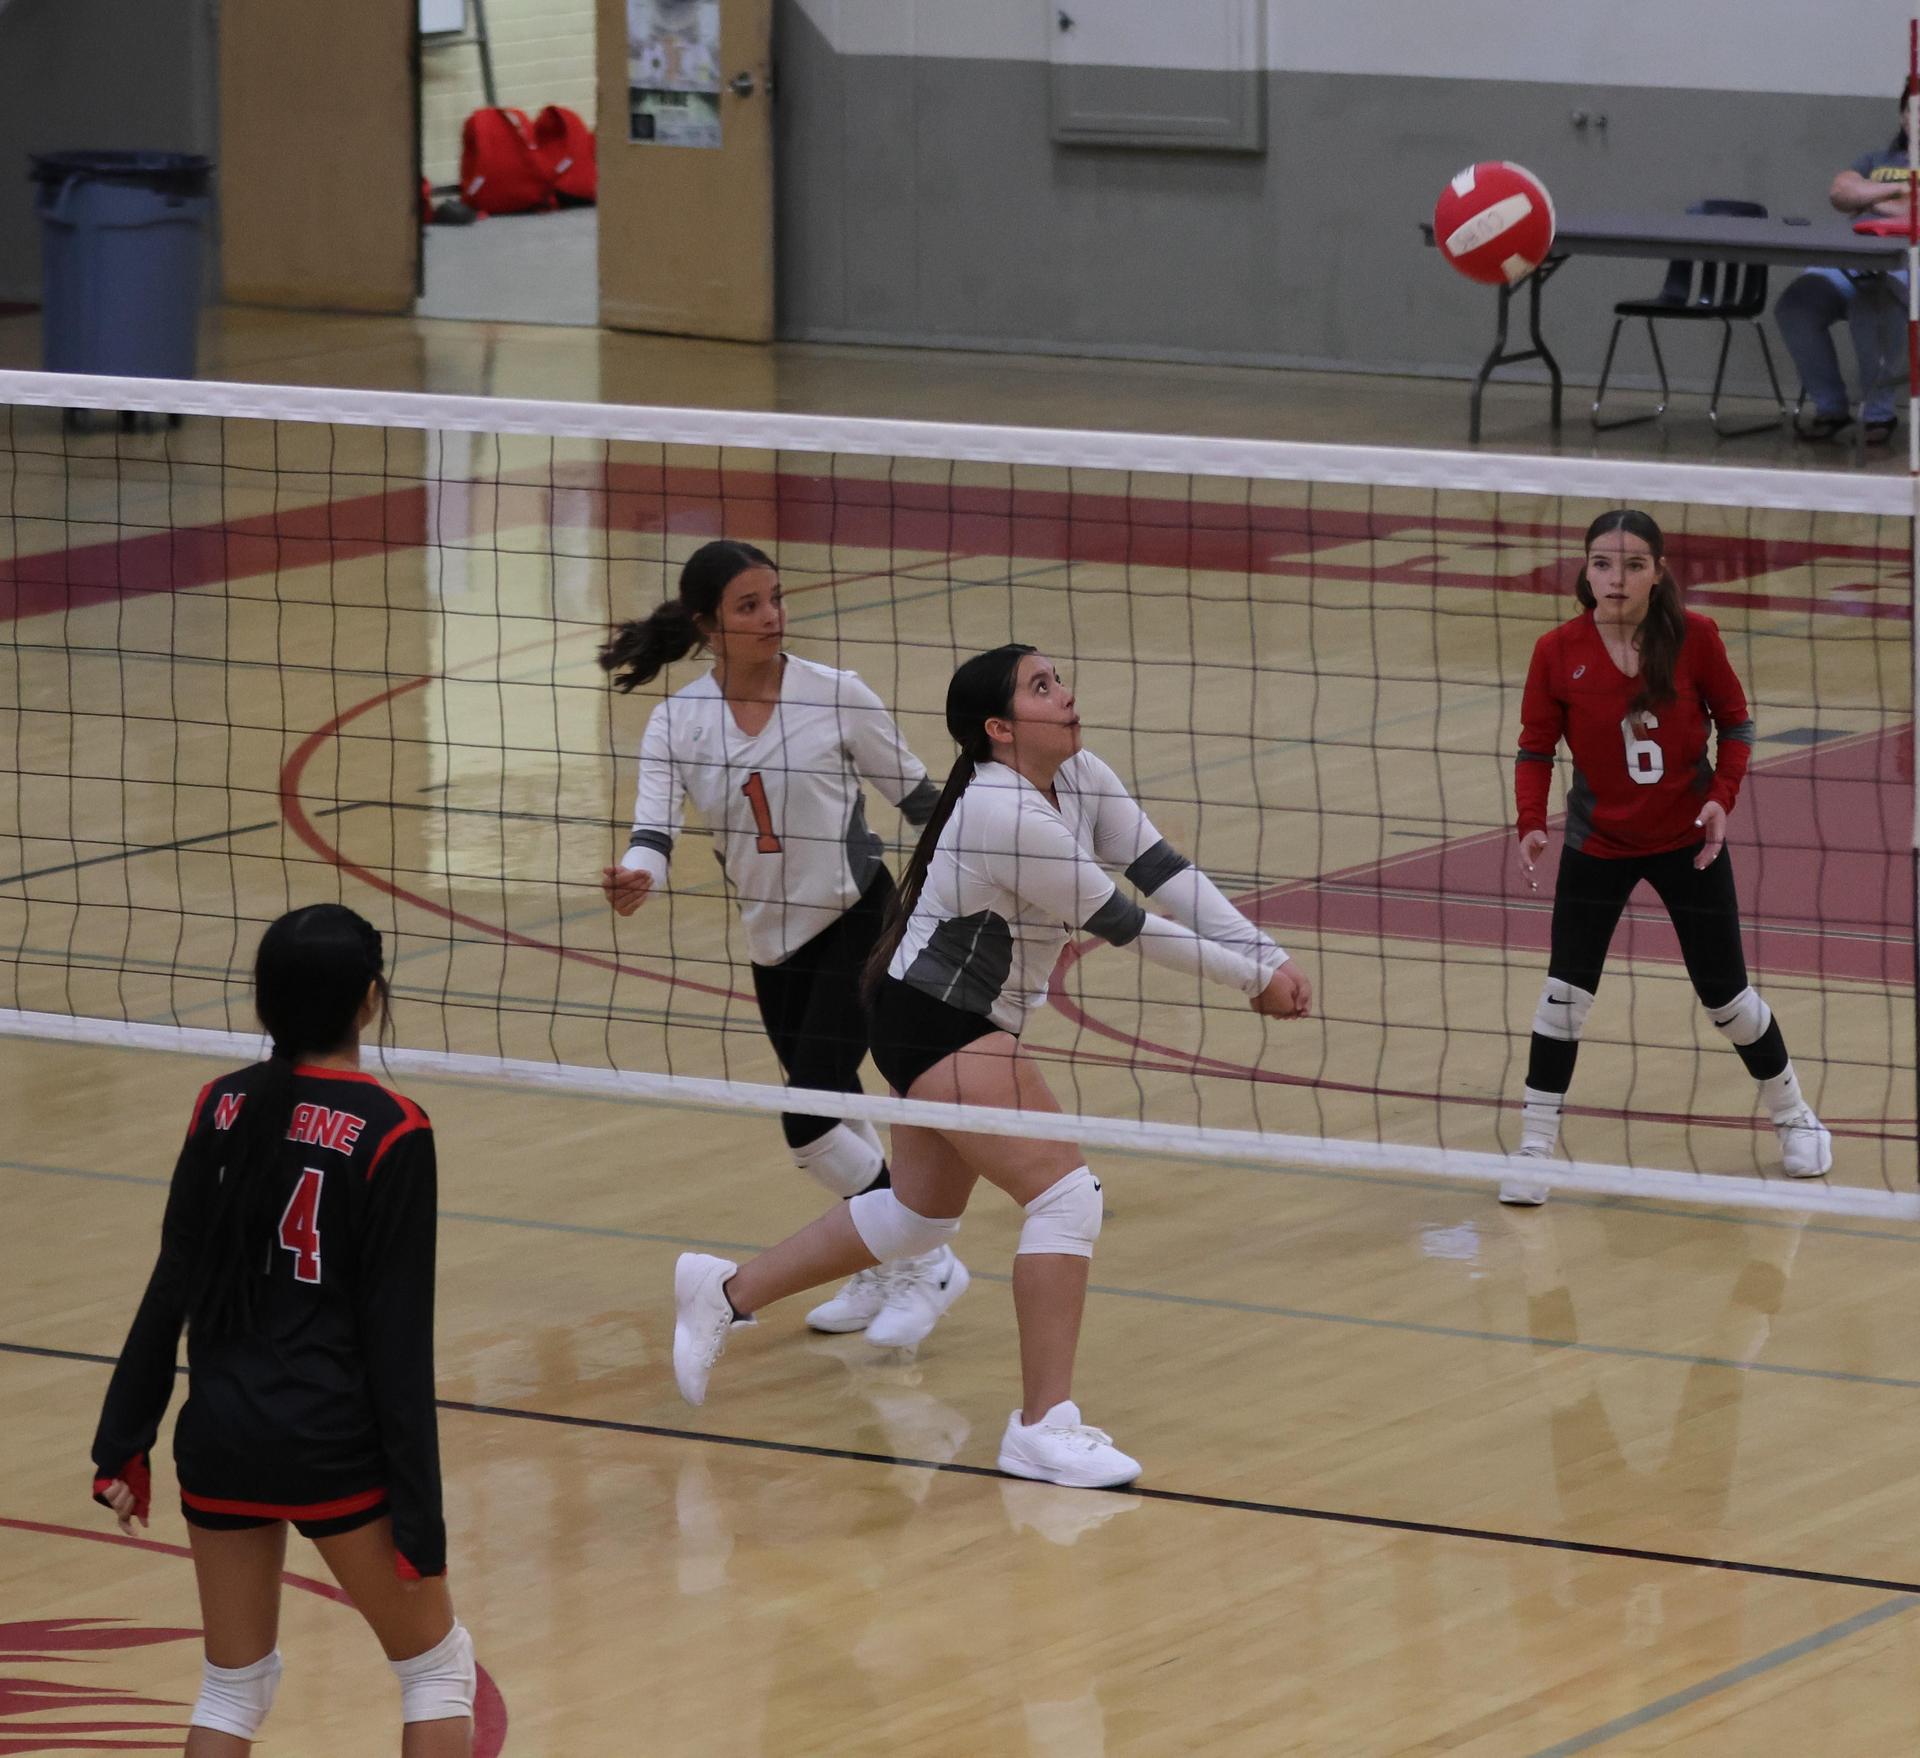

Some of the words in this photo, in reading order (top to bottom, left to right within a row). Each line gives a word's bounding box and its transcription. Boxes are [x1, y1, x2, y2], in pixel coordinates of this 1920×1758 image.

[1621, 710, 1664, 785] 6
[741, 772, 783, 854] 1
[214, 1093, 366, 1157] MANE
